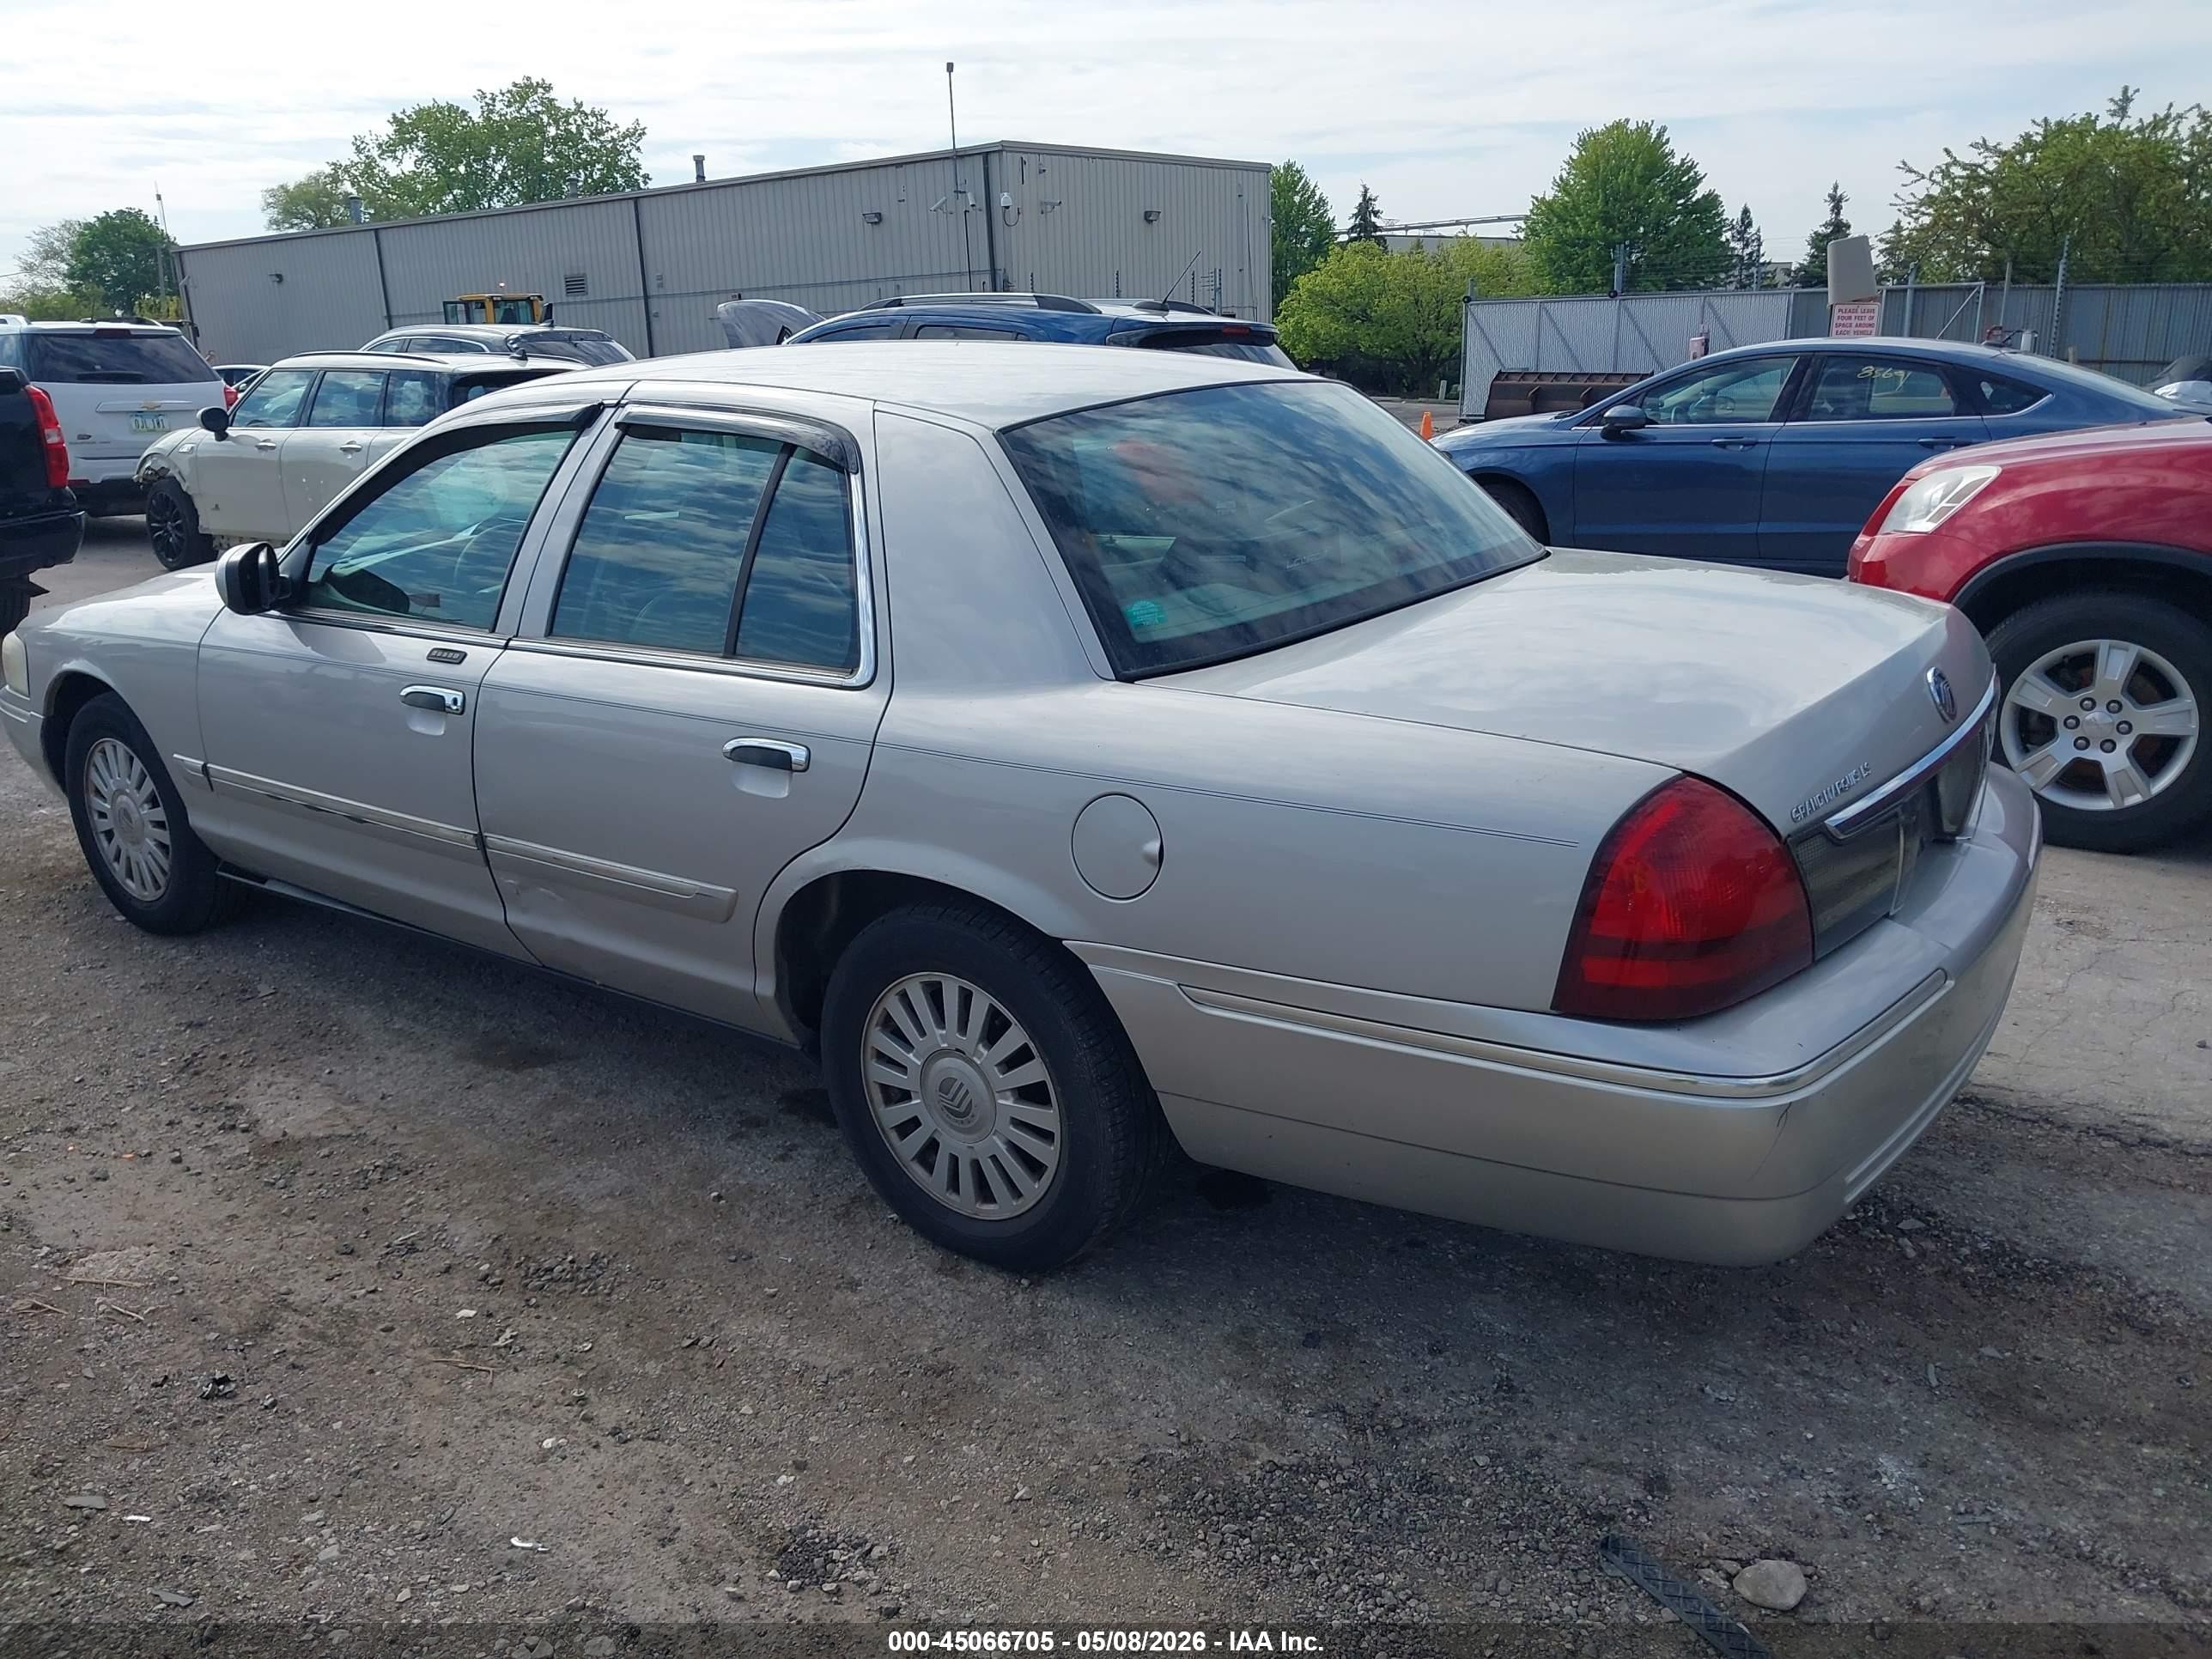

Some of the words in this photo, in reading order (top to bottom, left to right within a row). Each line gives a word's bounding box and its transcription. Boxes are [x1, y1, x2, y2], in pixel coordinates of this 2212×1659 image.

[1790, 793, 1824, 823] GRAND
[1822, 769, 1860, 804] MARQUIS
[1859, 762, 1872, 779] LS
